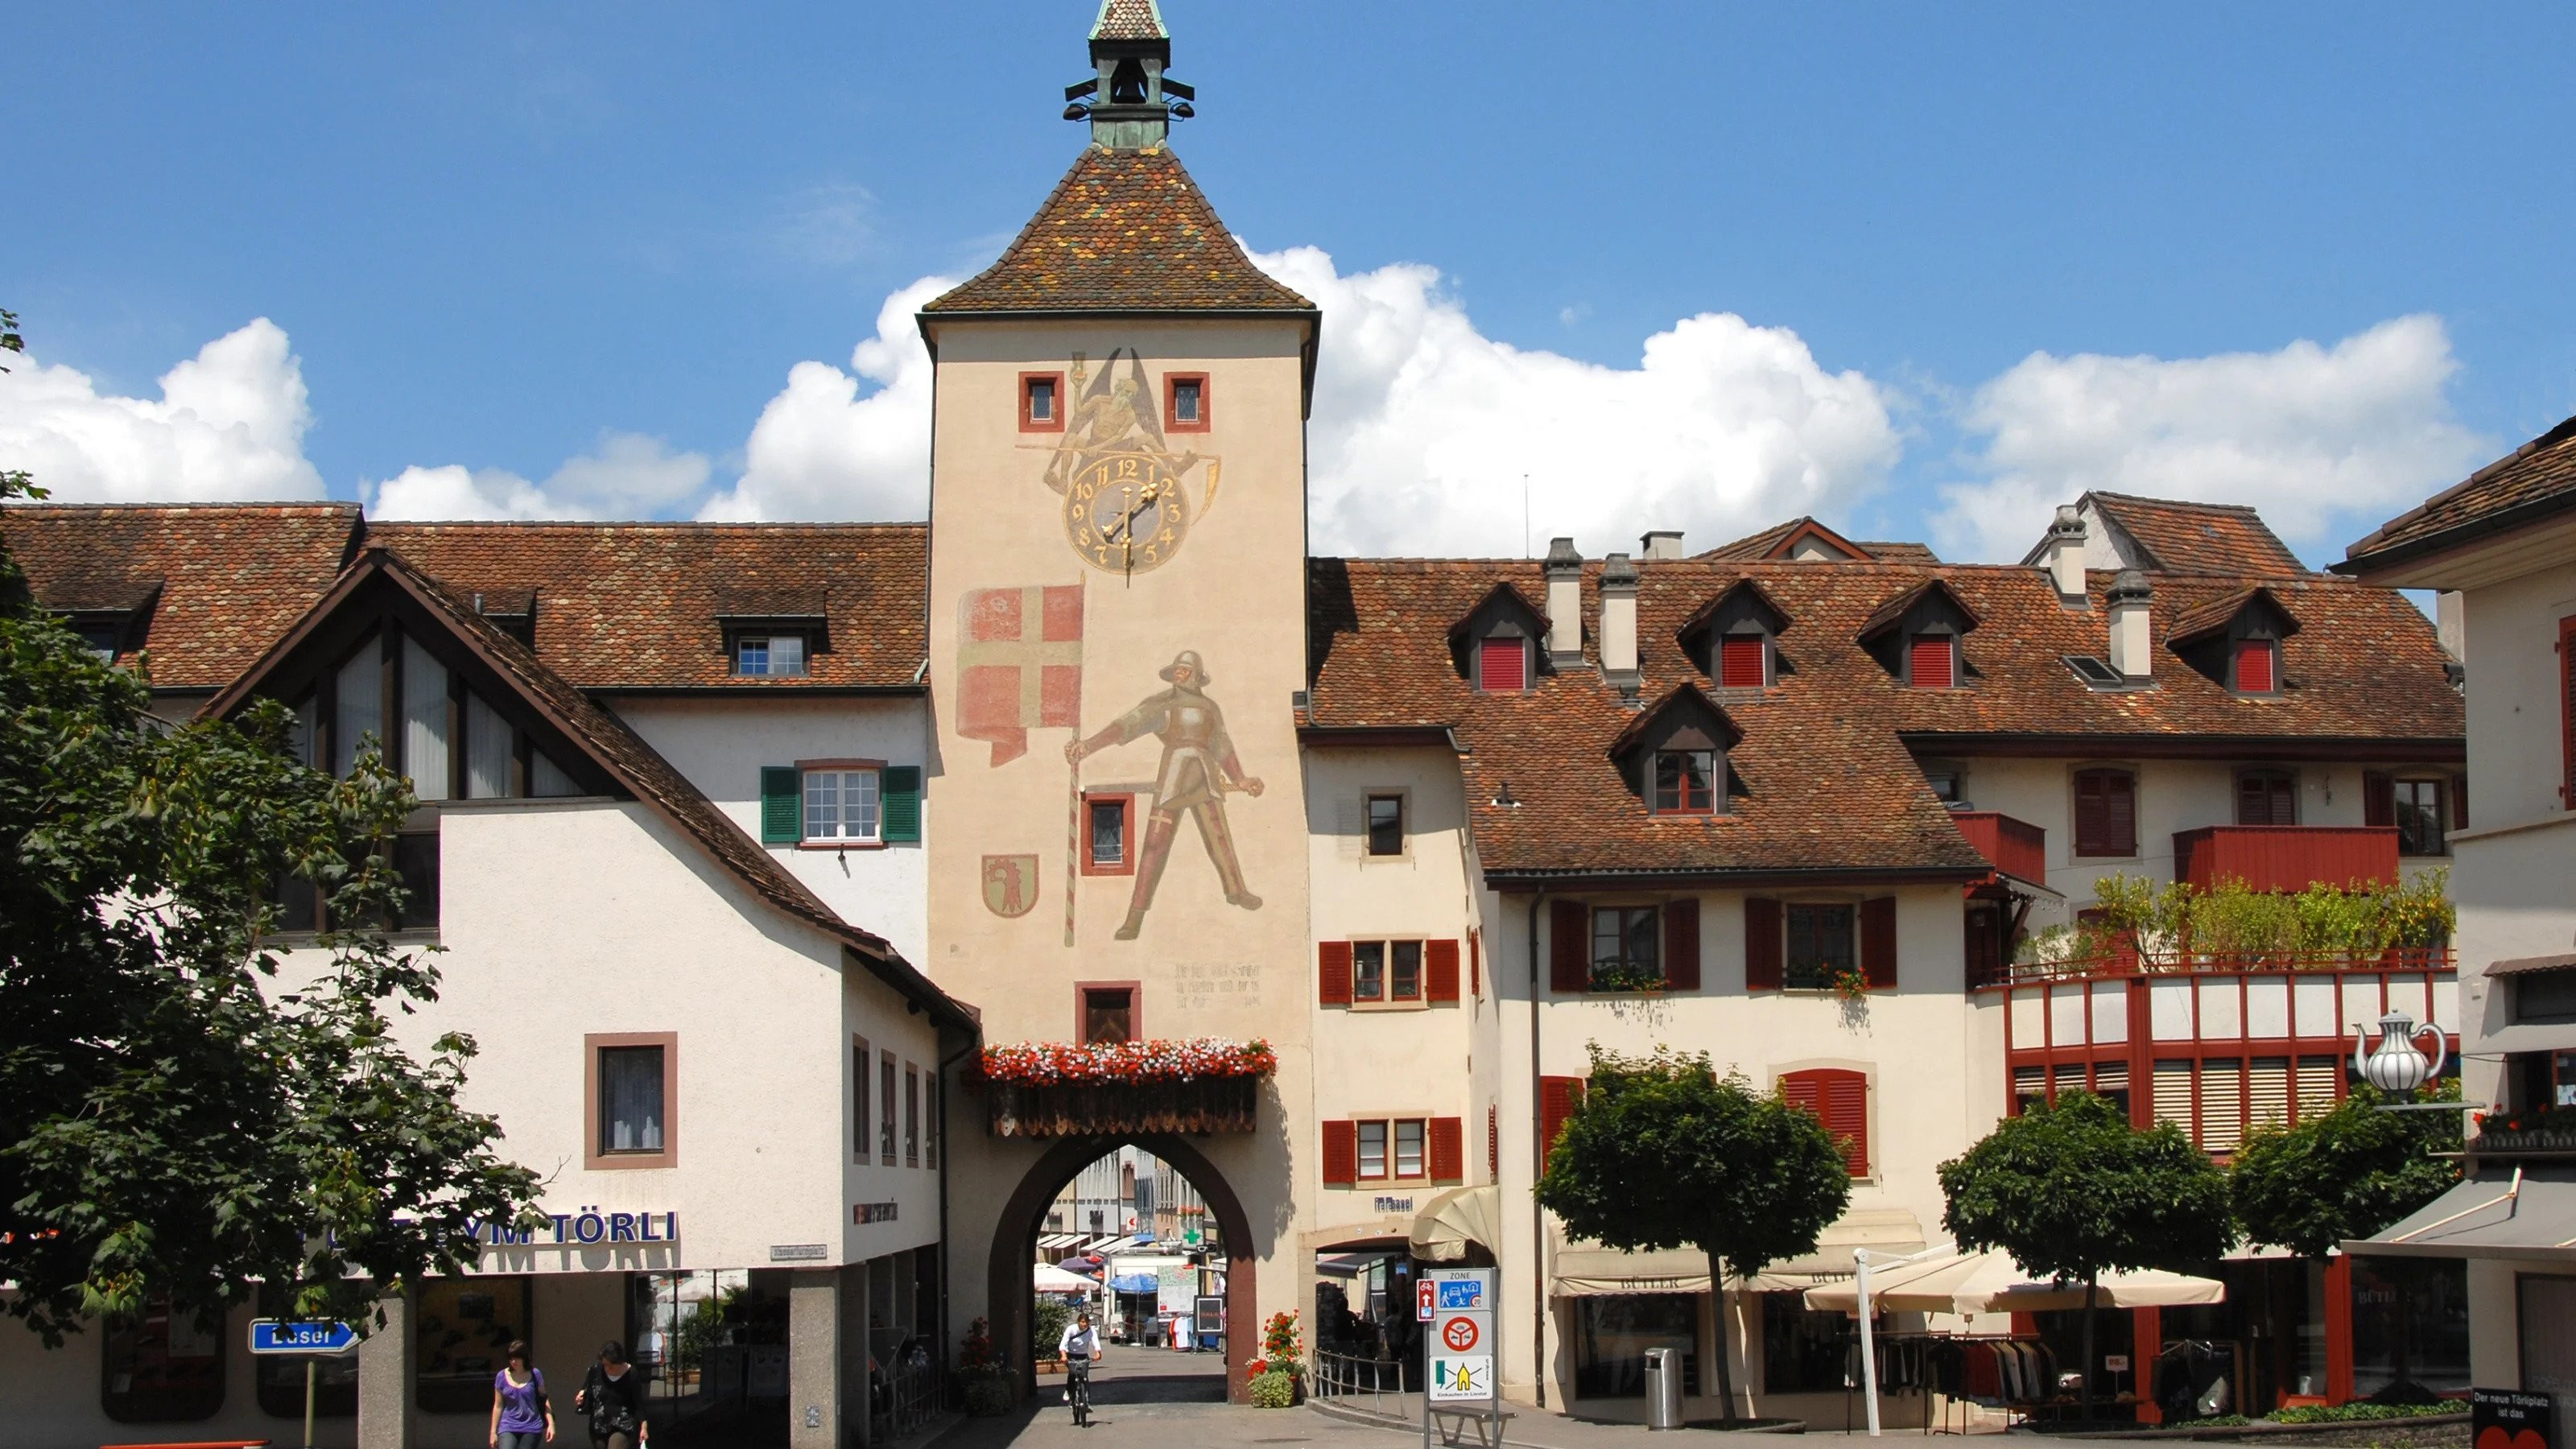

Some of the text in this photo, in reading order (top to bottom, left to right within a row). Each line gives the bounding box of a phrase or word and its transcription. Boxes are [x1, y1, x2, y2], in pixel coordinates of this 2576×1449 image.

[1096, 465, 1109, 485] 11
[1117, 459, 1139, 477] 12
[1147, 464, 1155, 483] 1
[1075, 483, 1094, 501] 10
[1161, 477, 1175, 497] 2
[1072, 504, 1085, 521] 9
[1168, 503, 1181, 522] 3
[1078, 527, 1091, 546] 8
[1159, 527, 1175, 546] 4
[1094, 545, 1108, 564] 7
[1145, 545, 1157, 564] 5
[548, 1205, 677, 1244] TÖRLI
[1450, 1272, 1470, 1280] ZONE
[1620, 1275, 1680, 1289] BÜTLER
[2474, 1392, 2487, 1402] Der
[2490, 1395, 2509, 1404] neue
[2512, 1394, 2549, 1406] Törliplatz
[2498, 1407, 2524, 1418] ist das
